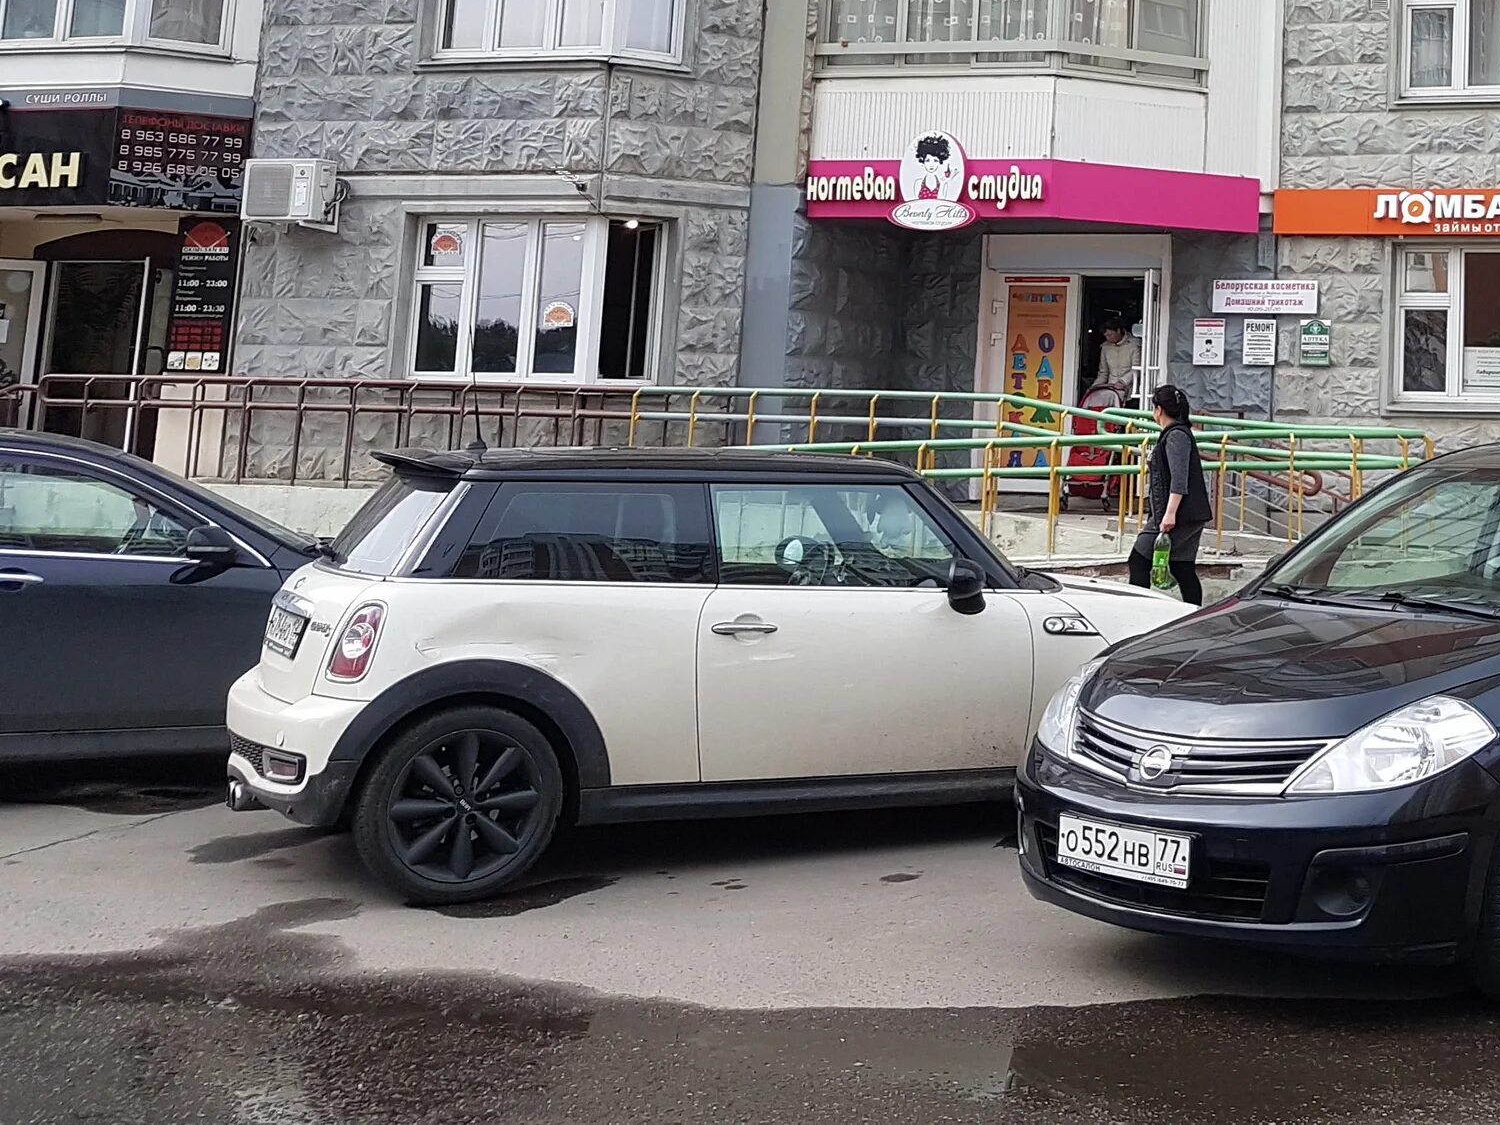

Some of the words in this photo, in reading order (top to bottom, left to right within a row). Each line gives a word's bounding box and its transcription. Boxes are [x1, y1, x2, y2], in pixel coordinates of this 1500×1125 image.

[25, 94, 60, 104] СУШИ
[64, 93, 107, 103] РОЛЛЫ
[121, 129, 131, 140] 8
[135, 131, 164, 142] 963
[169, 132, 197, 144] 686
[202, 136, 219, 146] 77
[224, 137, 243, 148] 99
[120, 145, 130, 155] 8
[134, 146, 162, 157] 985
[168, 148, 195, 160] 775
[200, 150, 218, 162] 77
[222, 152, 241, 163] 99
[0, 151, 81, 189] САН
[118, 160, 128, 171] 8
[133, 161, 162, 173] 926
[166, 163, 195, 175] 685
[199, 166, 218, 177] 05
[221, 167, 240, 179] 05
[807, 167, 896, 201] ногтевая
[968, 165, 1043, 210] студия
[897, 205, 933, 221] Beverly
[936, 205, 968, 219] Hills
[1434, 220, 1481, 233] займы
[1485, 222, 1500, 232] от
[1215, 281, 1269, 291] Белорусская
[1271, 282, 1316, 291] косметика
[1225, 297, 1265, 307] Домашний
[1267, 299, 1304, 308] трикотаж
[1246, 323, 1274, 332] РЕМОНТ
[1158, 838, 1180, 863] 77
[1060, 857, 1100, 871] АВТОСАЛОН
[1156, 862, 1173, 872] RUS
